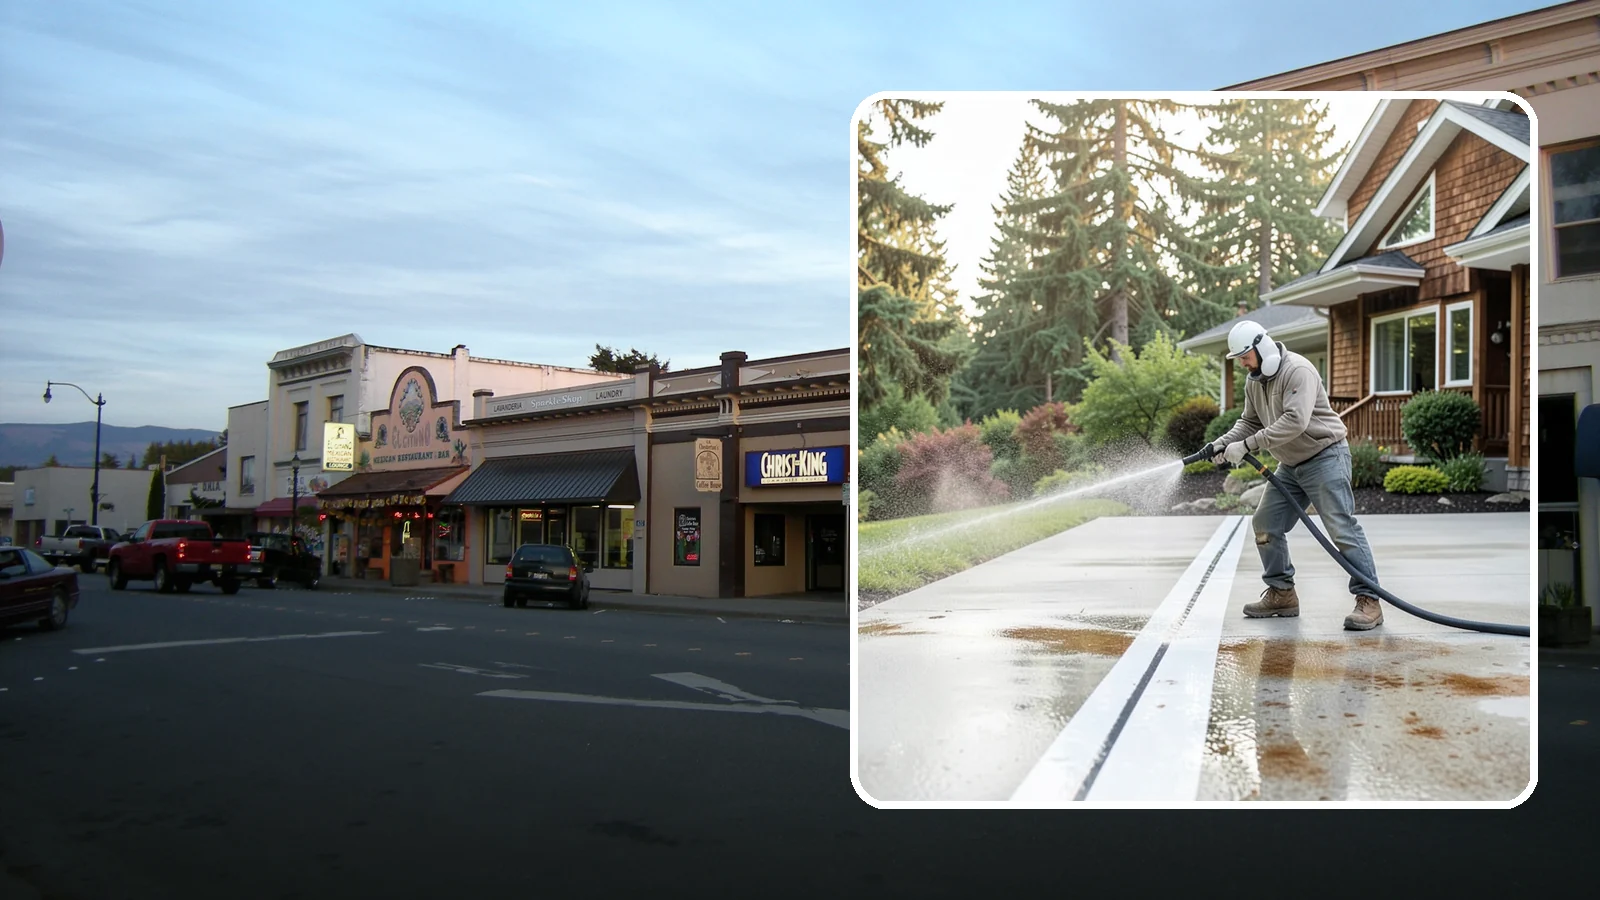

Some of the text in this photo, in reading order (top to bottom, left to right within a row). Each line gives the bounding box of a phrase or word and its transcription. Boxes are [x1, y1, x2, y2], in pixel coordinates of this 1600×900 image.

[531, 394, 582, 409] Sparkle Shop
[595, 389, 623, 400] LAUNDRY
[493, 402, 522, 413] LAVANDERIA
[373, 454, 396, 464] MEXICAN
[397, 451, 433, 462] RESTAURANT
[438, 450, 450, 459] BAR
[761, 450, 827, 478] CHRIST KING
